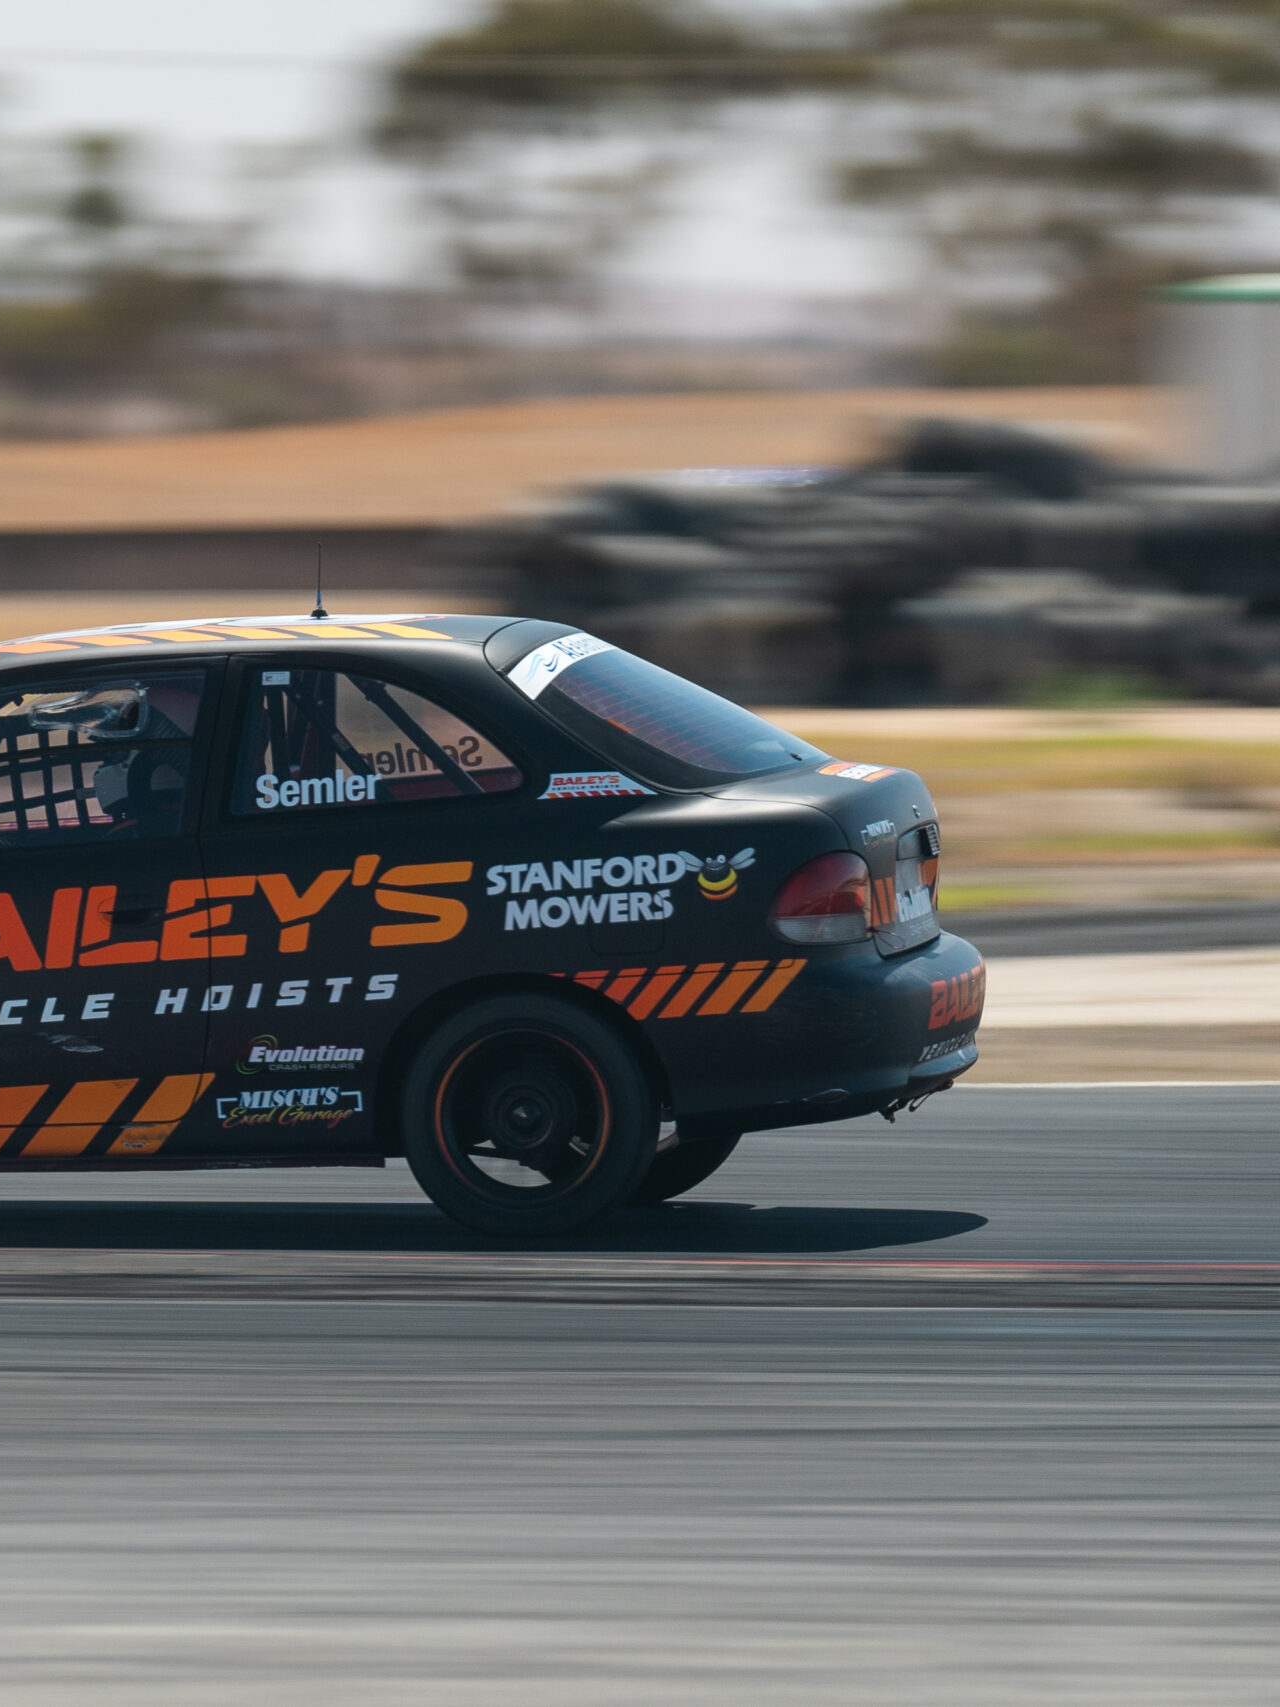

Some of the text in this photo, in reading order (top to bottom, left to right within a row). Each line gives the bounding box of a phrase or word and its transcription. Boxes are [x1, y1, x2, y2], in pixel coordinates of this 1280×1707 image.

[255, 768, 382, 809] Semler
[552, 774, 619, 786] BAILEY'S
[486, 853, 686, 896] STANFORD
[504, 889, 674, 931] MOWERS
[154, 974, 399, 1014] HOISTS
[248, 1045, 365, 1063] Evolution
[268, 1062, 355, 1071] CRASH REPAIRS
[239, 1086, 340, 1109] MISCH'S
[222, 1102, 354, 1129] Excel Garage
